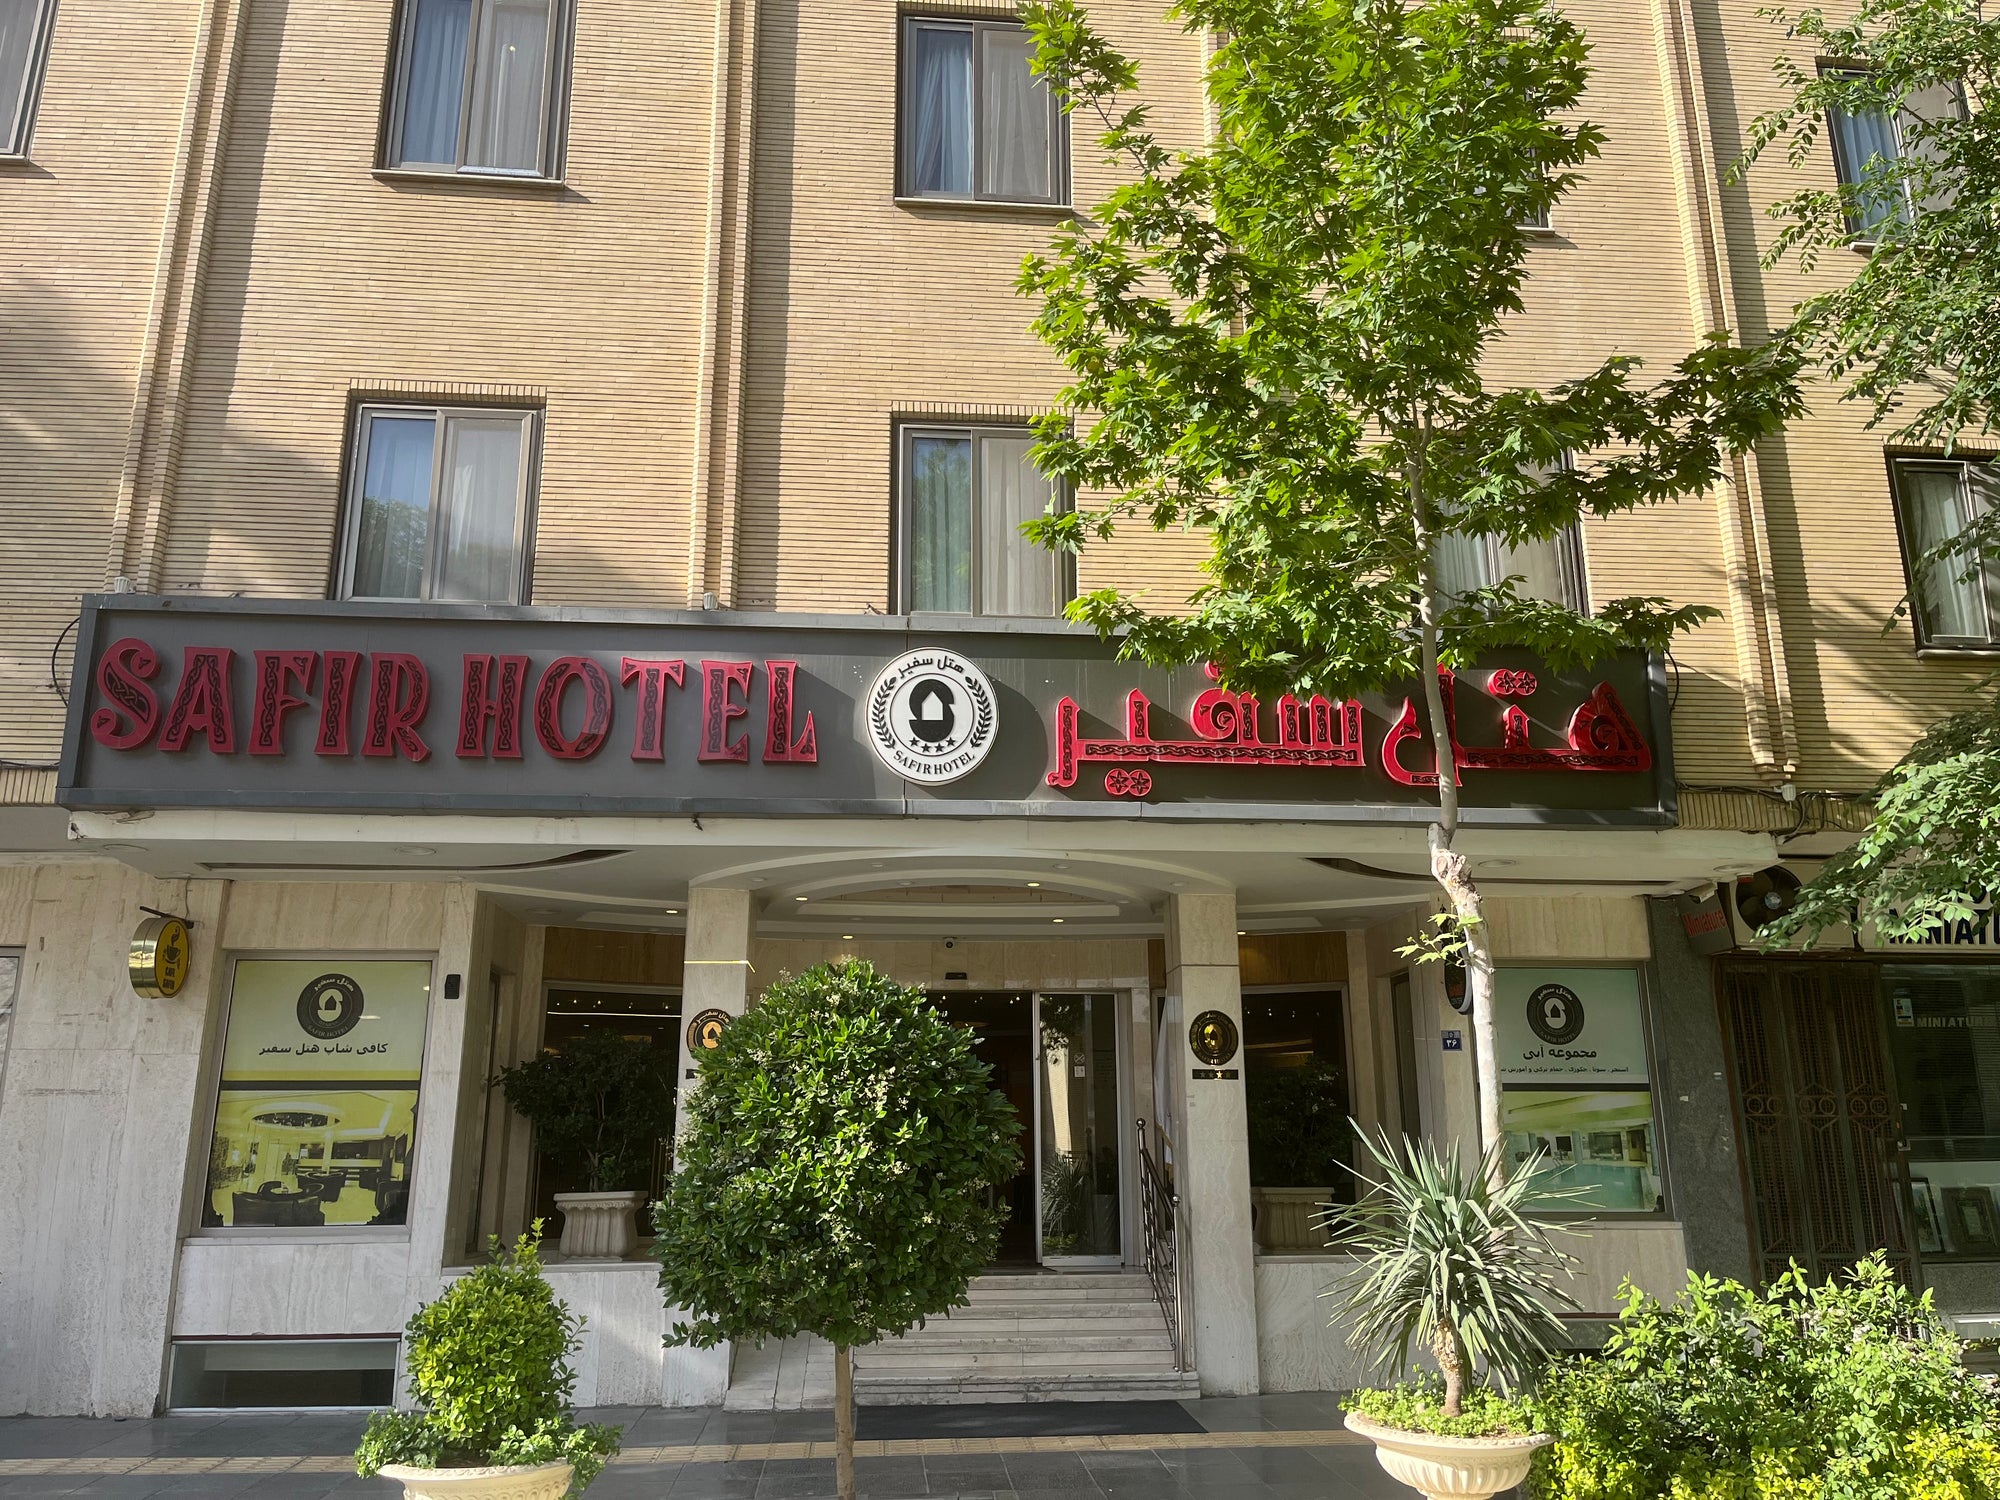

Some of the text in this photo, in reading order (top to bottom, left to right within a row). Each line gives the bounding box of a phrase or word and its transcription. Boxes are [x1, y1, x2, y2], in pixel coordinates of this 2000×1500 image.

[898, 656, 965, 679] هتل سفیر
[91, 637, 818, 763] SAFIR HOTEL
[1045, 660, 1651, 797] هتل سفیر
[894, 751, 976, 775] SAFIR HOTEL
[259, 1043, 388, 1056] کافی شاپ هتل سفیر
[1523, 1044, 1597, 1061] مجموعه آبی
